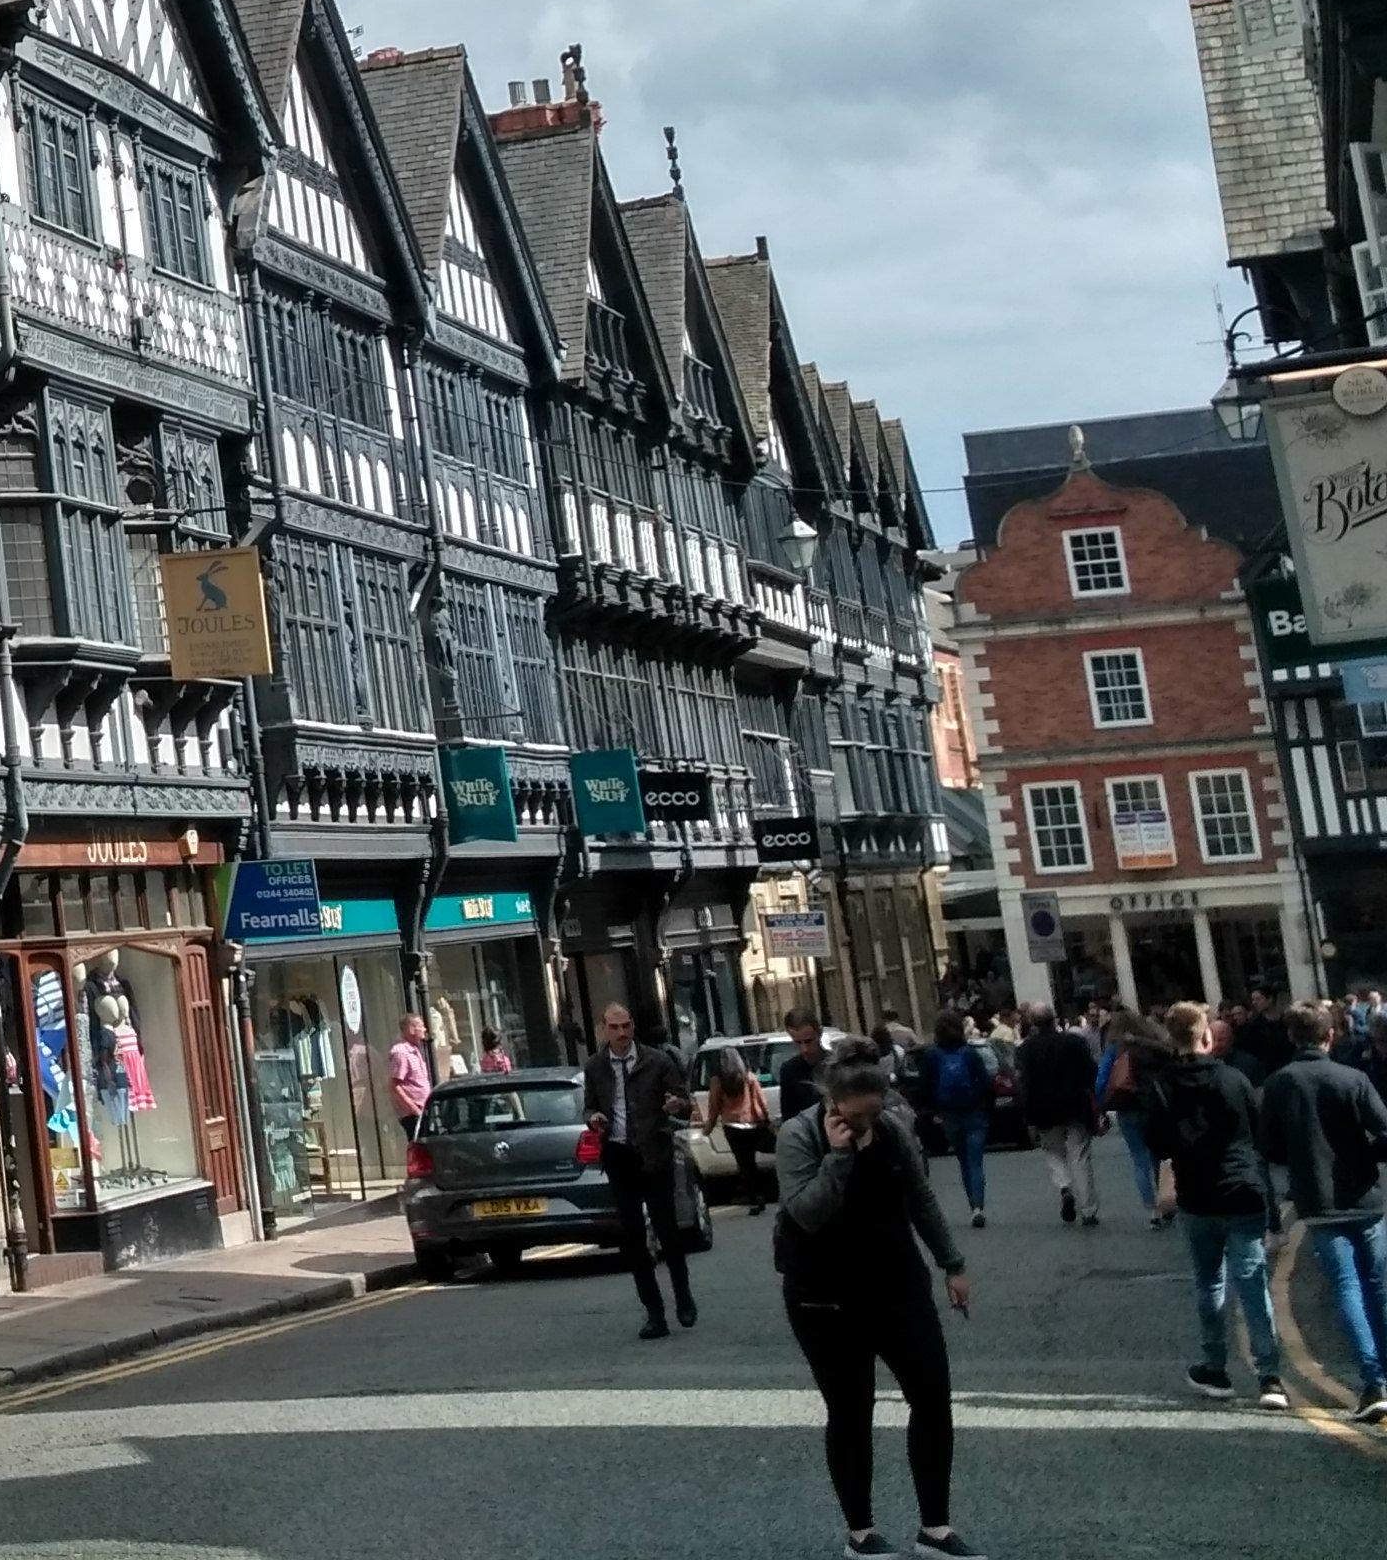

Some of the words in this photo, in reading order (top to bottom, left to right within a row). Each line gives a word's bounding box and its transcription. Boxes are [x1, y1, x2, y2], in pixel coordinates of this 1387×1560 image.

[178, 614, 256, 635] JOULES
[645, 791, 700, 807] ecco
[88, 826, 147, 863] JOULES
[762, 832, 811, 848] ecco
[262, 863, 283, 876] TO
[287, 861, 310, 875] LET
[268, 874, 312, 886] OFFICES
[240, 908, 320, 929] Fearnalls
